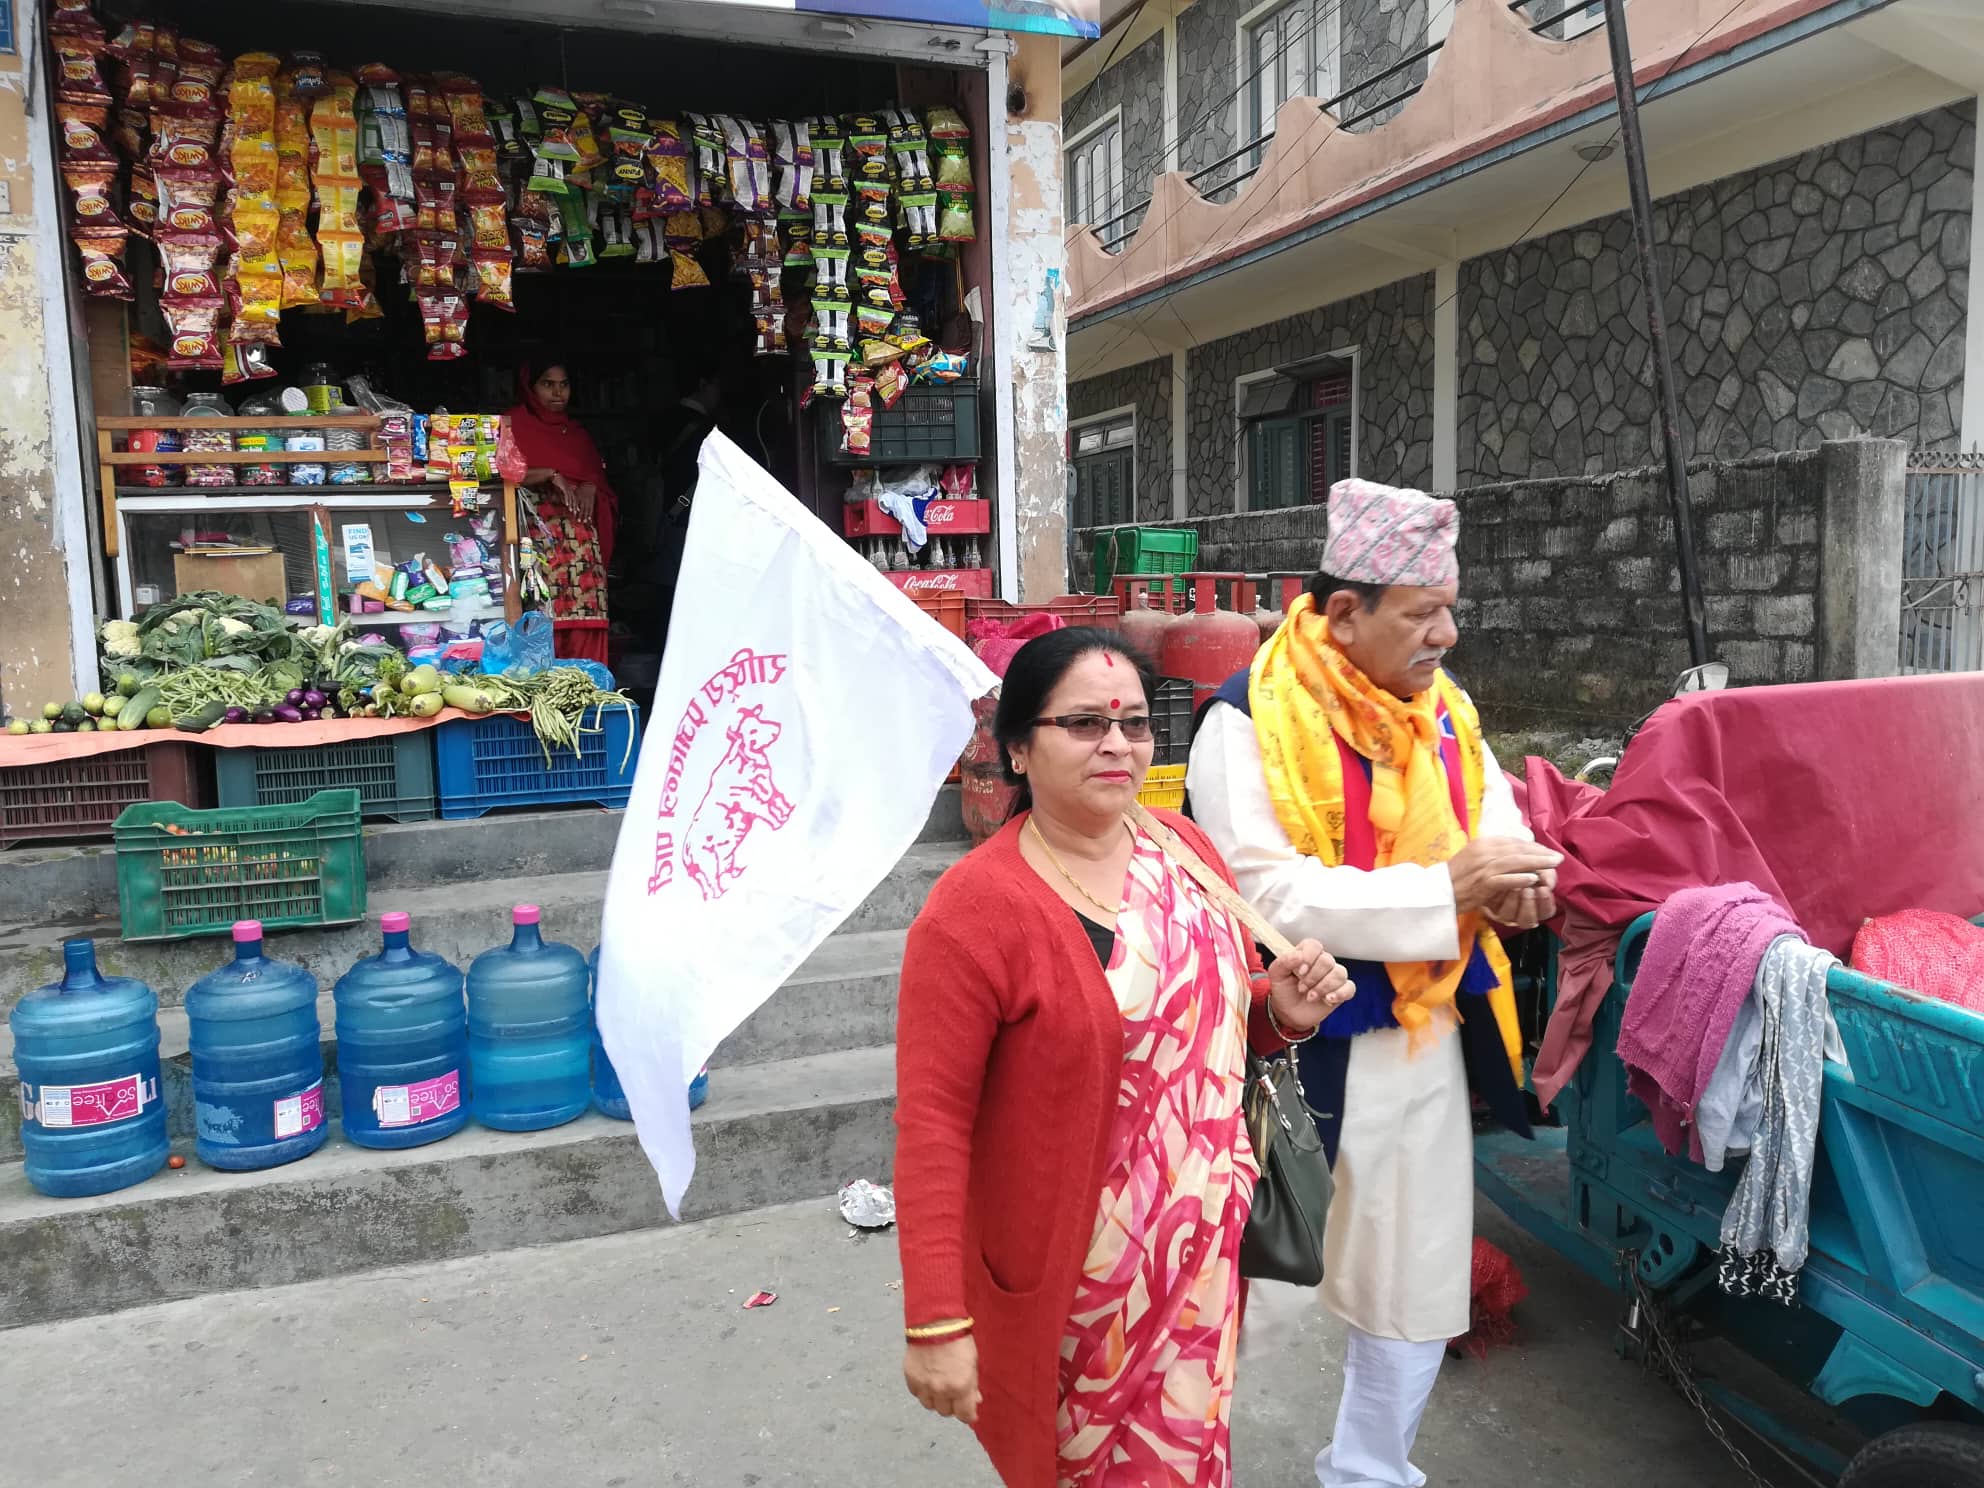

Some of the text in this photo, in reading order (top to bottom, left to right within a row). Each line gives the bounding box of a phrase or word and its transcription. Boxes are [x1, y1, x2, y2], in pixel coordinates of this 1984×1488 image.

[174, 150, 206, 163] Kwiks
[175, 214, 207, 227] Kwiks
[87, 264, 114, 279] Kwiks
[175, 278, 206, 292] Kwiks
[177, 342, 207, 355] Kwiks
